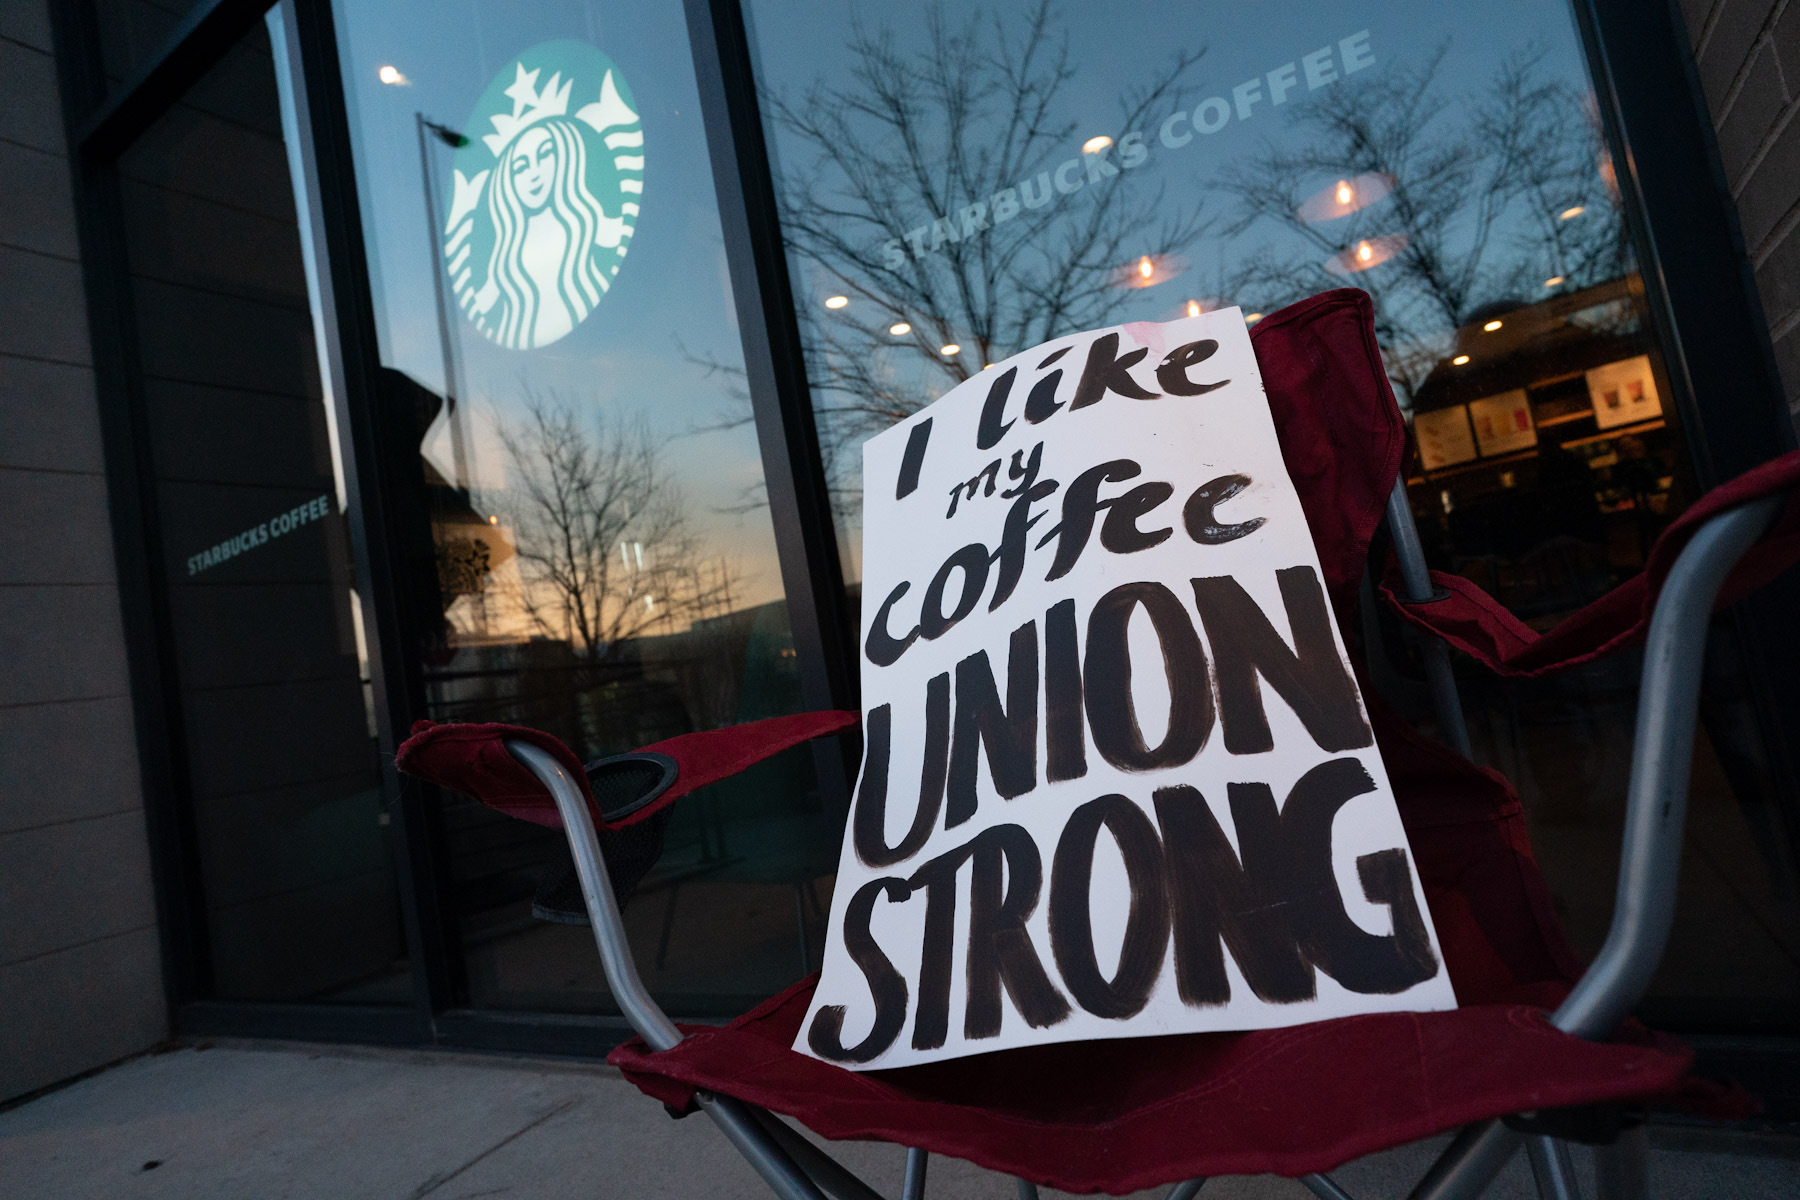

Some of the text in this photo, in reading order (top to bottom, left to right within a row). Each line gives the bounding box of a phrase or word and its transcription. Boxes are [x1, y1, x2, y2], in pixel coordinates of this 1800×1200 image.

[881, 29, 1376, 271] STARBUCKS COFFEE
[896, 332, 1232, 501] I like
[945, 441, 1045, 520] my
[187, 495, 330, 576] STARBUCKS COFFEE
[864, 458, 1270, 668] coffee
[853, 564, 1374, 869] UNION
[807, 757, 1440, 1064] STRONG
